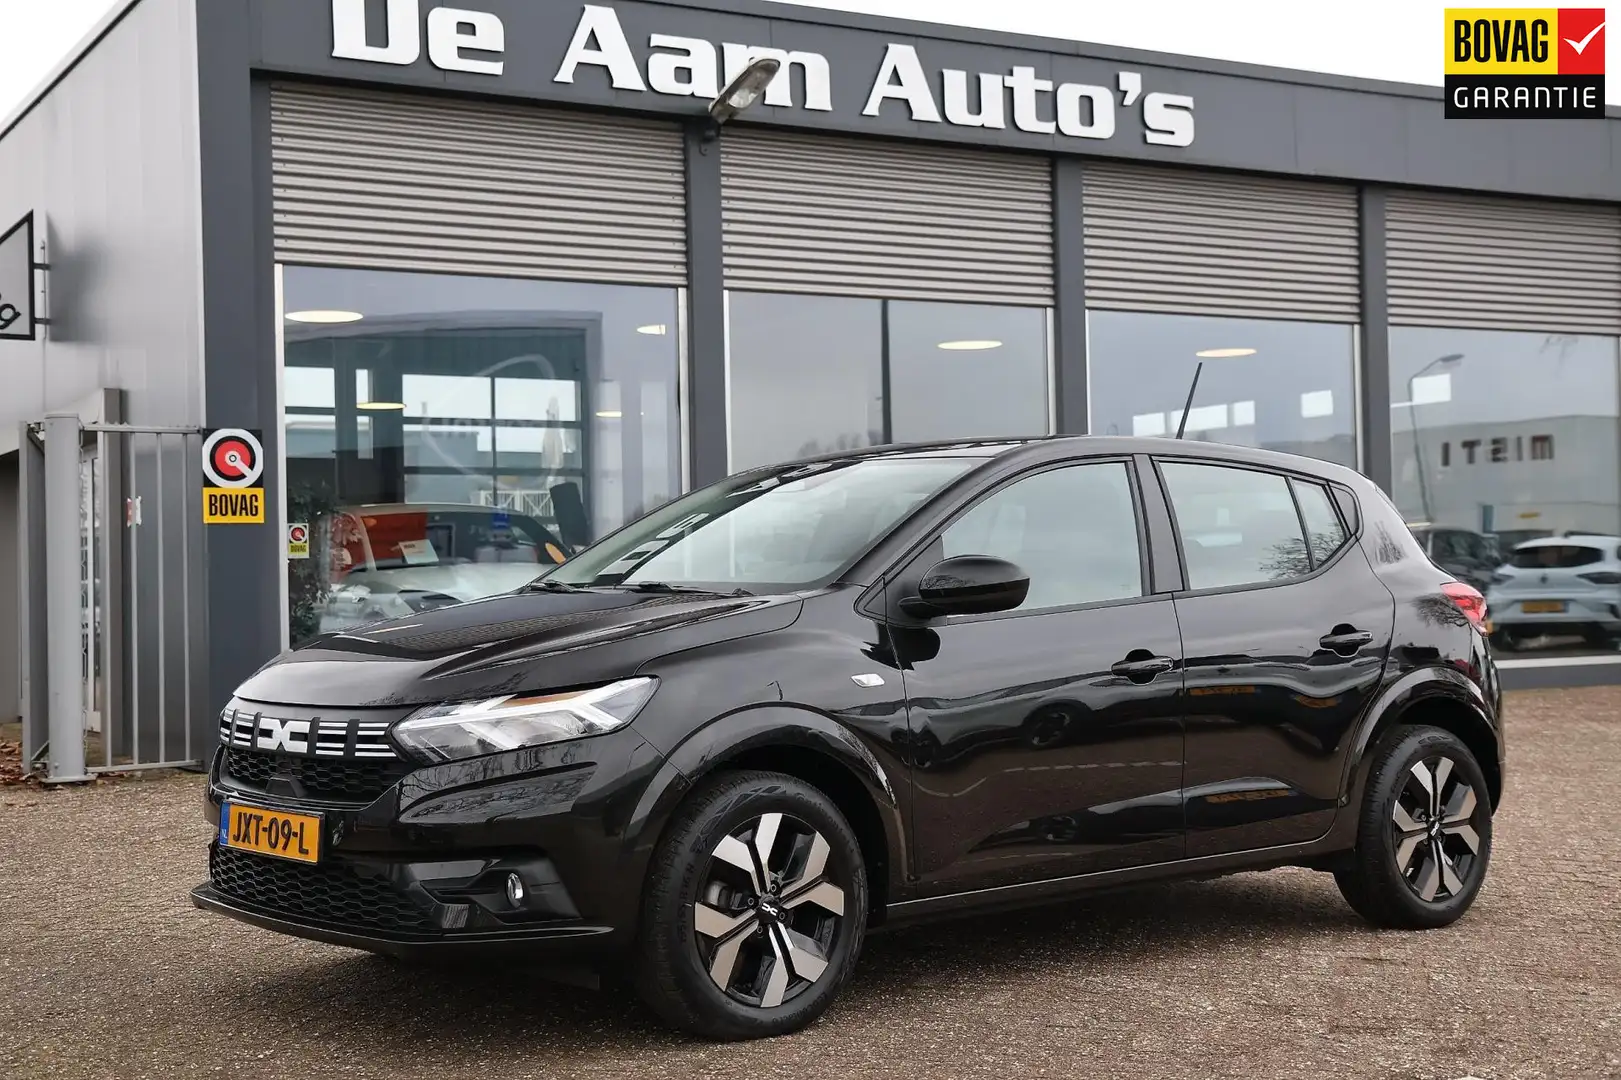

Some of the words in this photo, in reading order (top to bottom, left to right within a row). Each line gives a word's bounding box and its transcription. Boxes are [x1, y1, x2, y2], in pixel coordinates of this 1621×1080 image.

[331, 0, 504, 76] De
[553, 4, 833, 111] Aam
[862, 43, 1195, 147] Auto's
[208, 493, 259, 516] BOVAG
[233, 811, 309, 855] JXT-09-L
